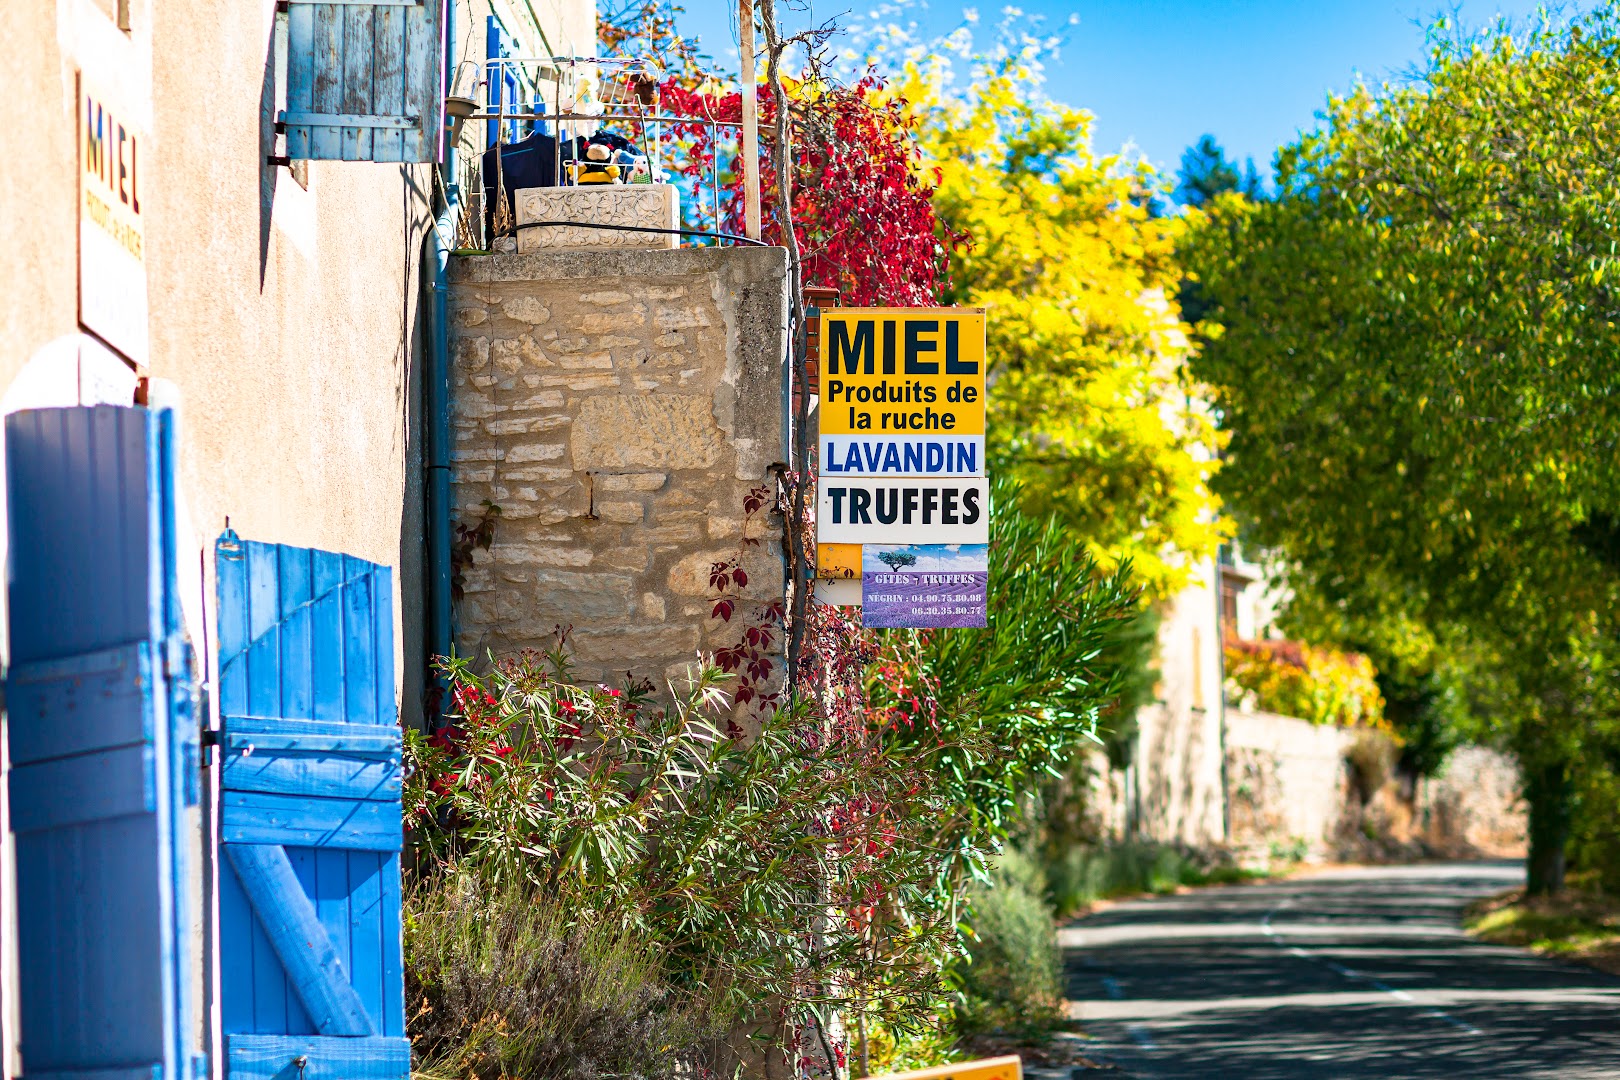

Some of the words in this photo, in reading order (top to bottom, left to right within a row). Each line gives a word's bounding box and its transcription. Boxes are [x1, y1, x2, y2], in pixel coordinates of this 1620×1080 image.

[87, 95, 140, 214] MIEL
[828, 320, 978, 375] MIEL
[828, 380, 938, 403] Produits
[946, 380, 978, 403] de
[849, 407, 872, 430] la
[881, 407, 956, 430] ruche
[827, 442, 976, 473] LAVANDIN
[828, 488, 980, 525] TRUFFES
[922, 574, 975, 584] TRUFFES
